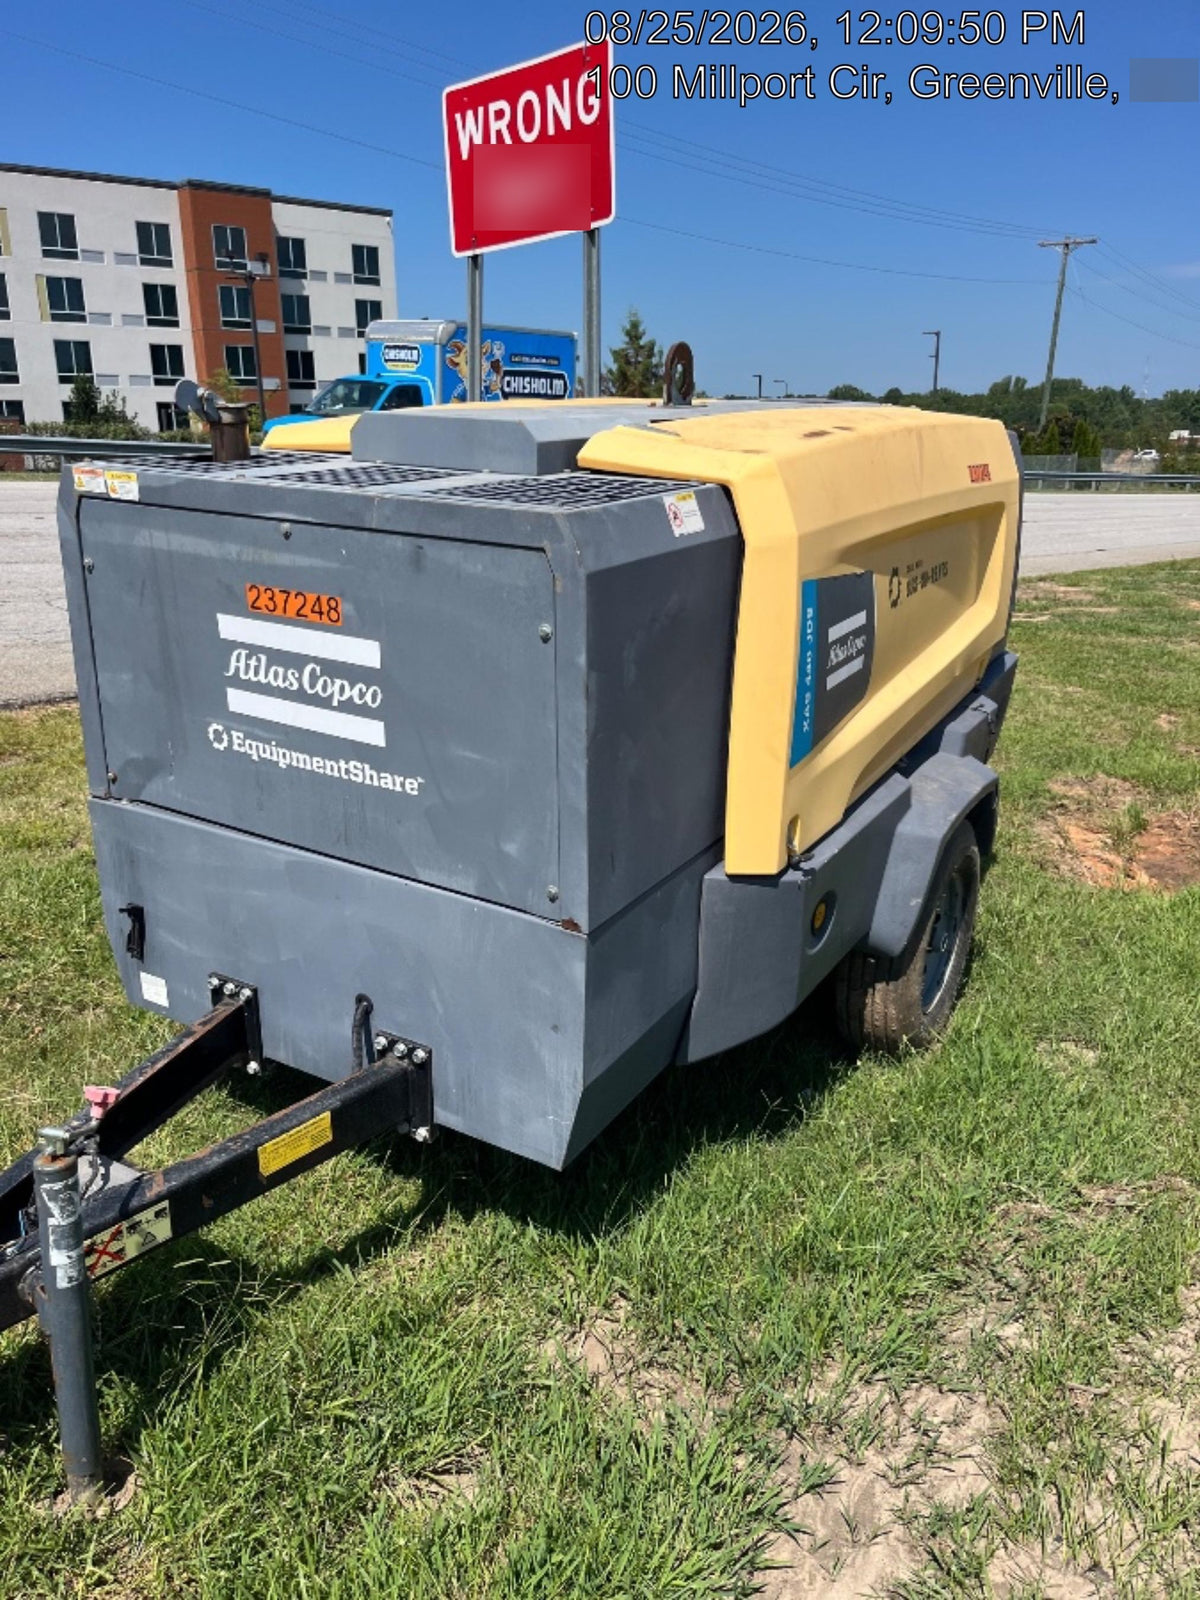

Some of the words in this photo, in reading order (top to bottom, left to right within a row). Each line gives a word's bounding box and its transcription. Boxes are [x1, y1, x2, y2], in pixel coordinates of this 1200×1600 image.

[454, 68, 600, 161] WRONG
[503, 376, 564, 395] CHISHOLM
[248, 584, 341, 623] 237248
[224, 648, 299, 690] Atlas
[302, 662, 383, 708] Copco
[230, 729, 419, 796] EquipmentShare
